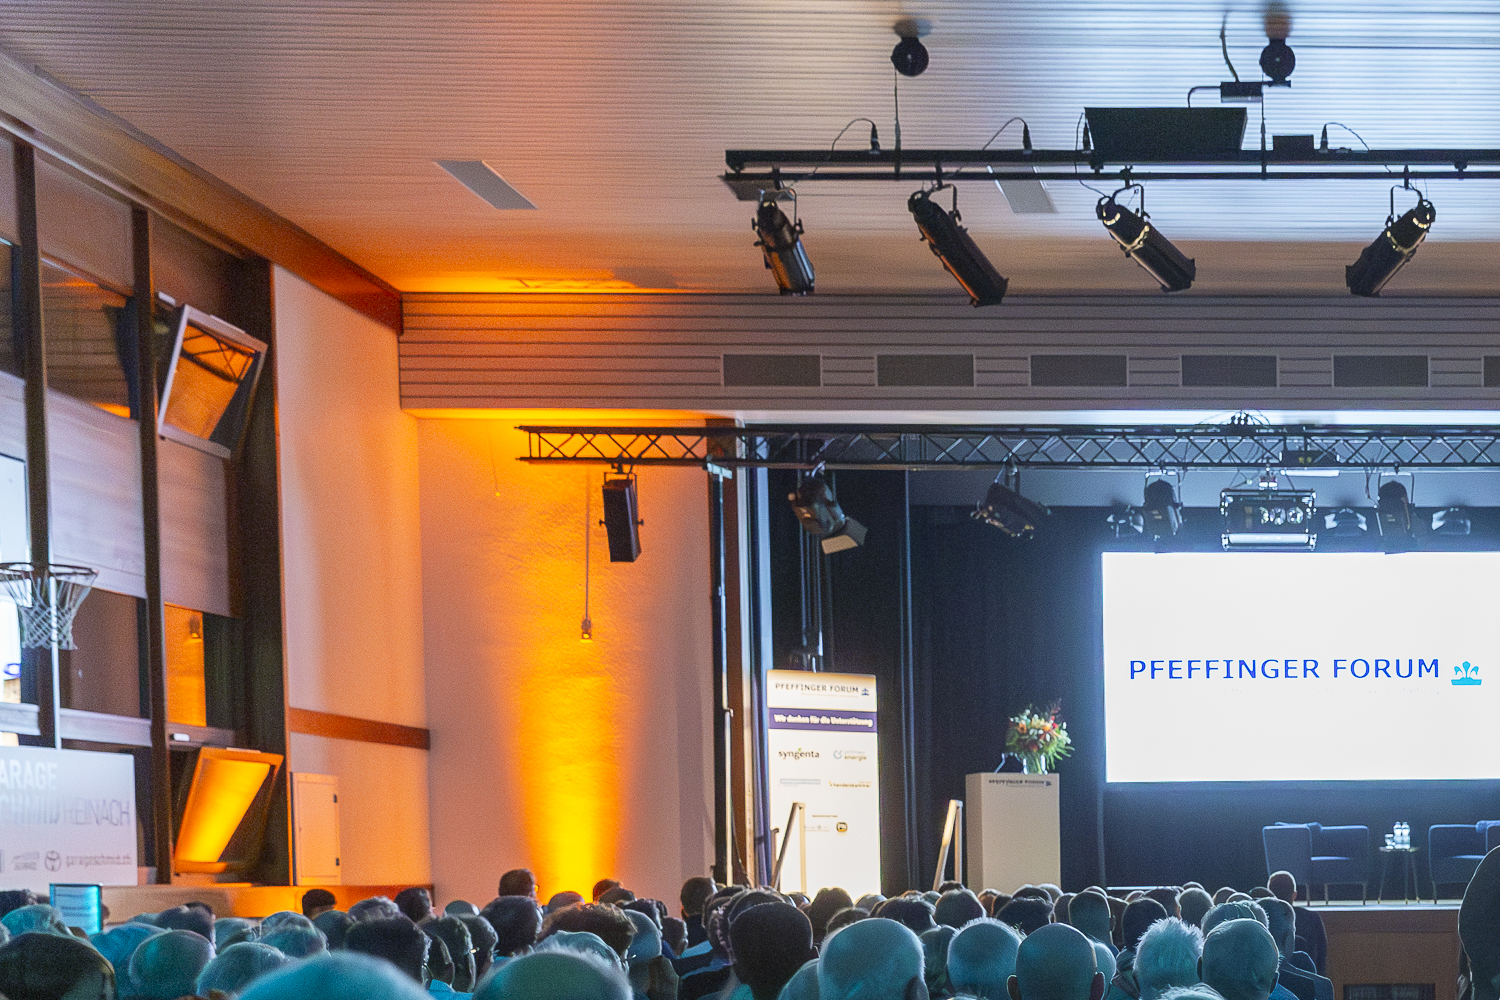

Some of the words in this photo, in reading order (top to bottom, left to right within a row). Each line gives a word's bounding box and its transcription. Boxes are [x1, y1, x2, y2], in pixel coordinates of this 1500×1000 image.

[1129, 659, 1320, 680] PFEFFINGER
[1332, 658, 1440, 679] FORUM
[775, 683, 827, 692] PFEFFINGER
[829, 685, 859, 693] FORUM
[778, 749, 820, 760] syngenta
